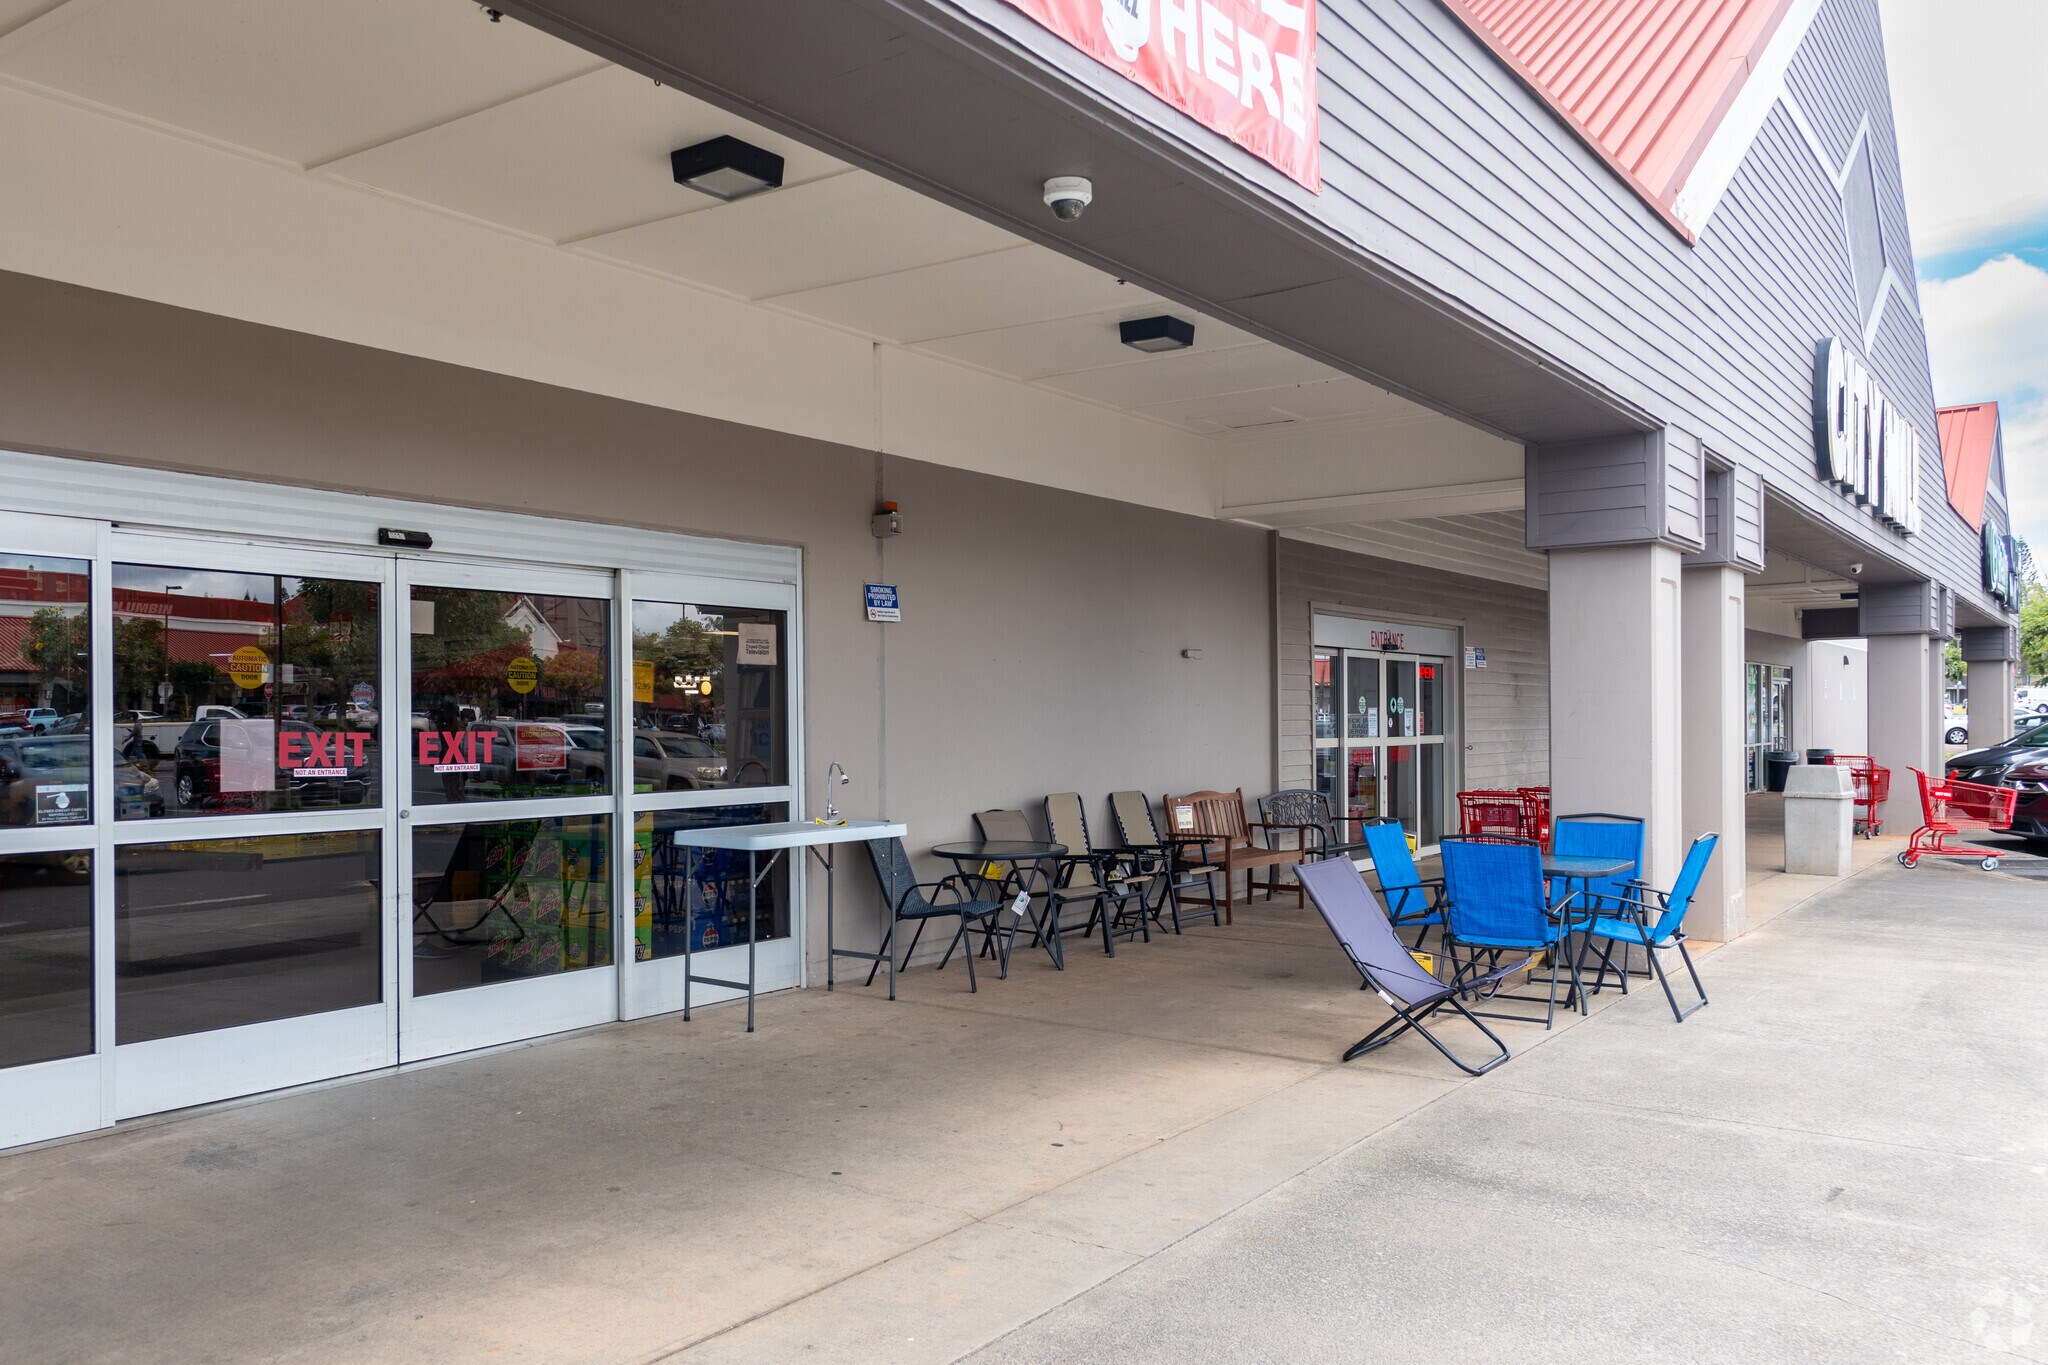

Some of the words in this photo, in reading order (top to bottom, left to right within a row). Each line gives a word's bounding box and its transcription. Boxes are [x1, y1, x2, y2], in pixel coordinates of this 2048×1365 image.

[1160, 0, 1306, 142] HERE
[1371, 630, 1404, 650] ENTRANCE
[230, 663, 268, 672] CAUTION
[508, 671, 536, 679] CAUTION
[1419, 665, 1434, 679] PEN
[279, 732, 371, 767] EXIT
[419, 731, 498, 764] EXIT
